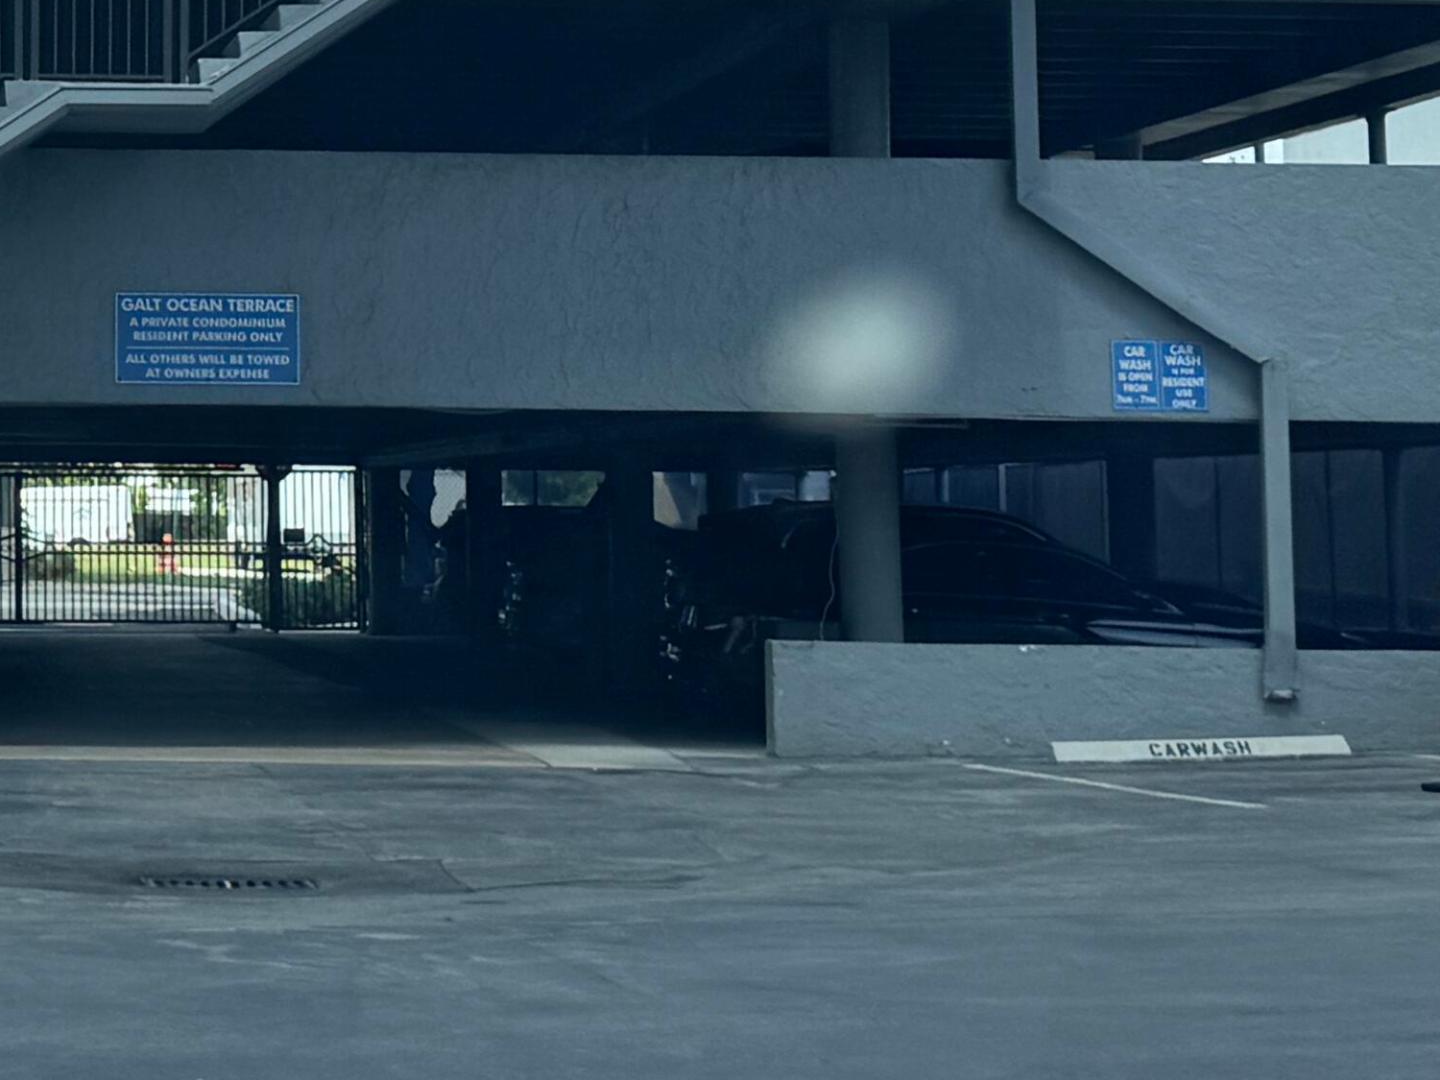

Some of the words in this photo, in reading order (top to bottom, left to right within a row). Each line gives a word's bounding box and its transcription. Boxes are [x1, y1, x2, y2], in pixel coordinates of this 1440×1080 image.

[121, 298, 161, 312] GALT
[167, 298, 223, 312] OCEAN
[227, 299, 295, 313] TERRACE
[129, 317, 139, 327] A
[141, 317, 189, 327] PRIVATE
[192, 317, 286, 328] CONDOMINIUM
[133, 331, 189, 341] RESIDENT
[192, 331, 247, 342] PARKING
[250, 332, 283, 342] ONLY
[1123, 345, 1146, 357] CAR
[1170, 344, 1194, 355] CAR
[125, 354, 147, 364] ALL
[150, 354, 195, 364] OTHERS
[198, 354, 226, 365] WILL
[230, 355, 244, 365] BE
[247, 355, 290, 365] TOWED
[1119, 359, 1152, 371] WASH
[1164, 355, 1201, 367] WASH
[145, 368, 161, 378] AT
[164, 368, 216, 379] OWNERS
[219, 369, 270, 379] EXPENSE
[1128, 372, 1153, 381] OPEN
[1123, 383, 1148, 392] FROM
[1162, 377, 1205, 387] RESIDENT
[1175, 389, 1193, 398] USE
[1172, 399, 1197, 409] ONLY
[1148, 740, 1253, 758] CARWASH
